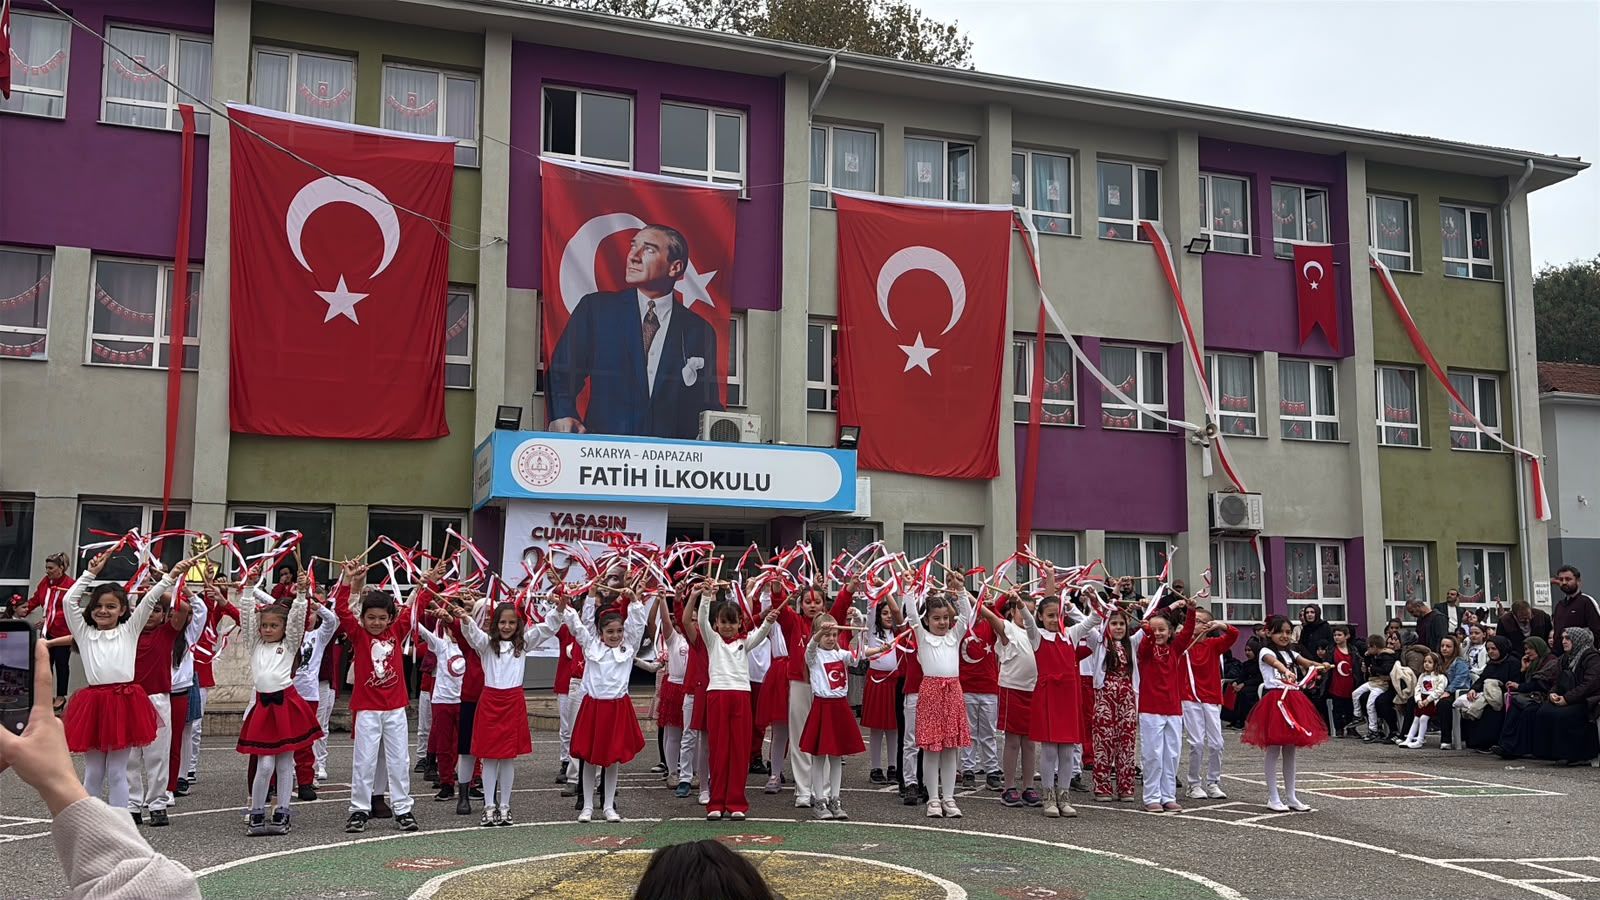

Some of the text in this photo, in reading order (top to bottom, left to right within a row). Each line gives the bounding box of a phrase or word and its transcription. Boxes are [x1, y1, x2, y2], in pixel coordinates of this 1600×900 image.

[580, 447, 631, 459] SAKARYA
[642, 449, 703, 462] ADAPAZARI
[579, 463, 647, 487] FATİH
[655, 464, 770, 491] İLKOKULU
[550, 512, 627, 529] YAŞASIN
[531, 527, 641, 544] CUMHURİT!
